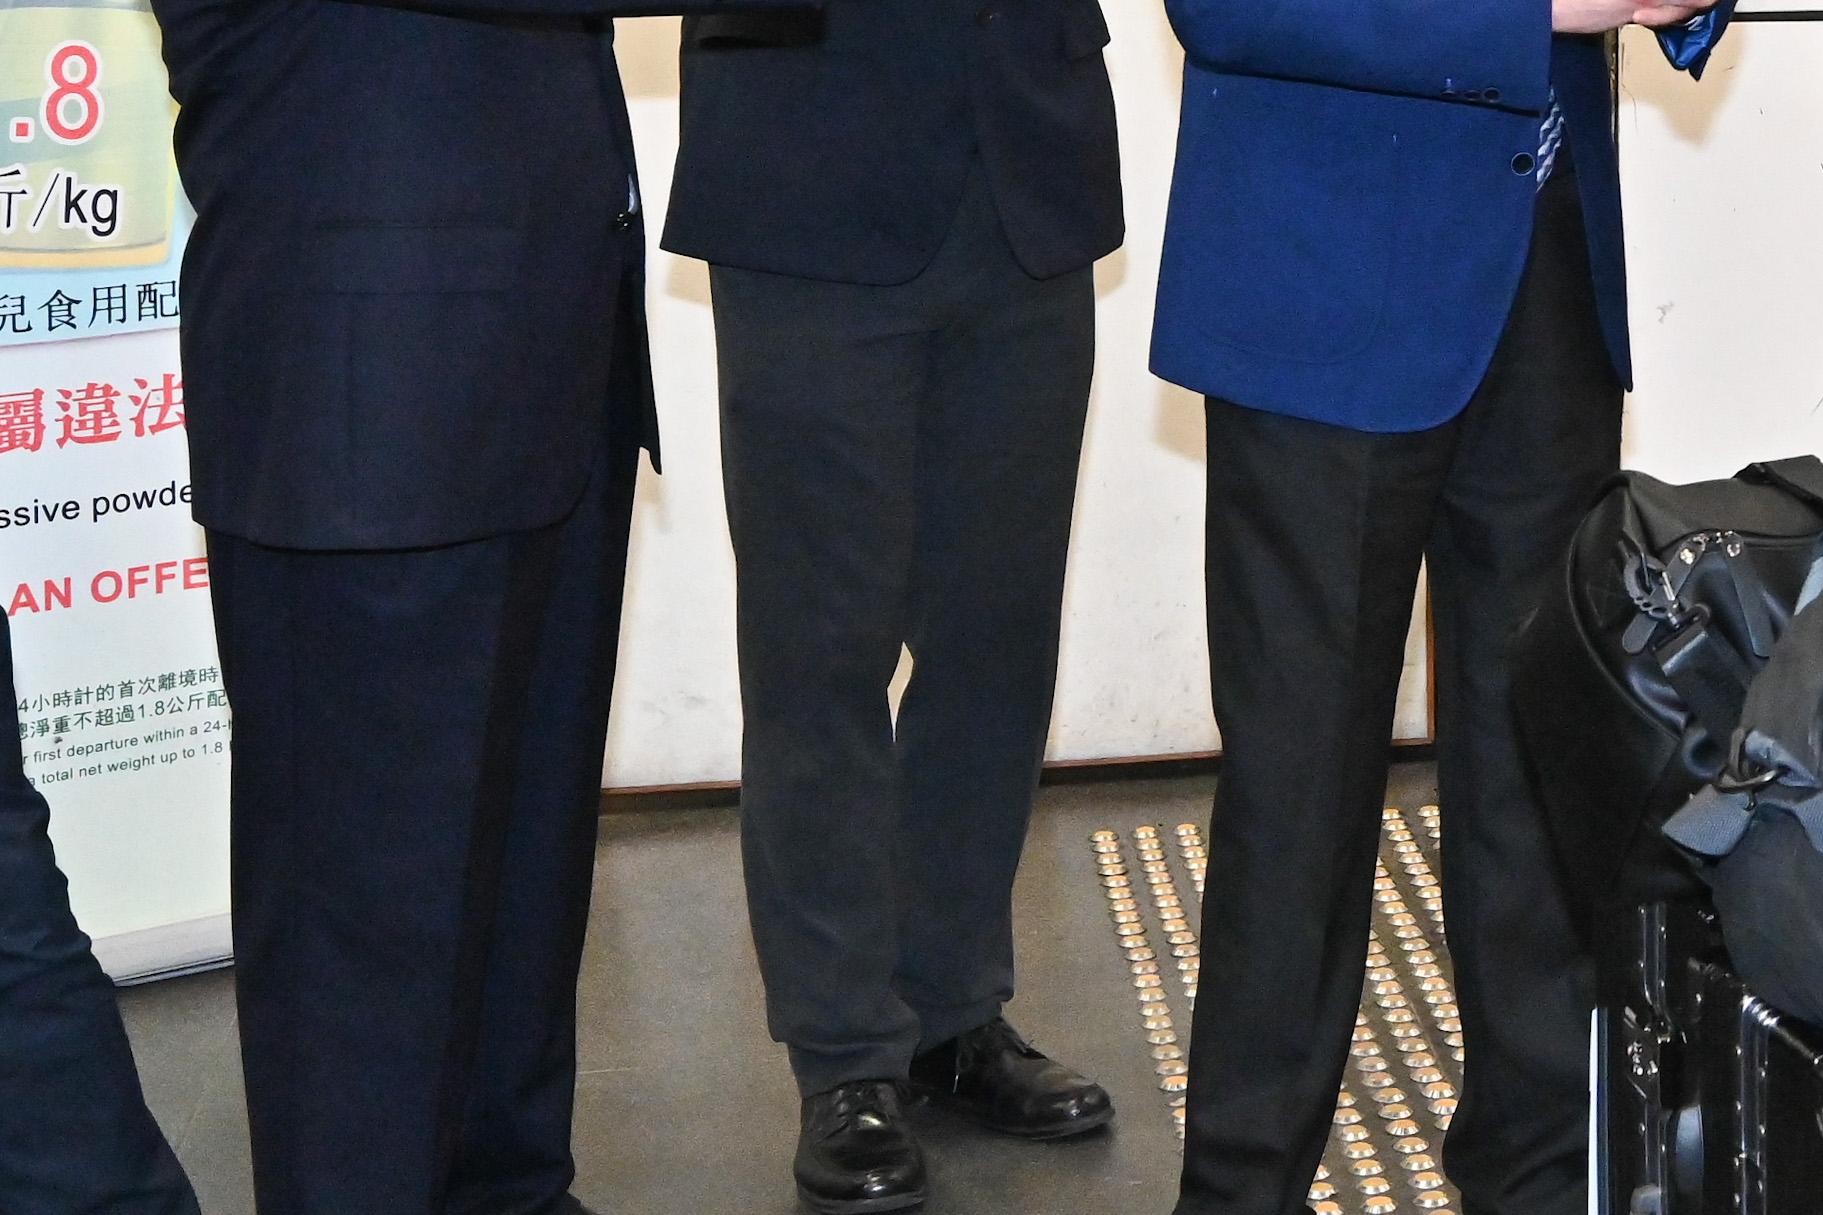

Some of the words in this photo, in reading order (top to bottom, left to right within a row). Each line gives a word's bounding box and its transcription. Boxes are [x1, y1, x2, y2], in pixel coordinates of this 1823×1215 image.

[15, 44, 99, 140] .8
[8, 576, 72, 616] AN
[90, 556, 208, 604] OFFE
[34, 746, 62, 764] first
[66, 735, 139, 760] departure
[143, 726, 185, 745] within
[190, 725, 198, 736] a
[42, 769, 73, 785] total
[79, 764, 102, 779] net
[107, 754, 155, 773] weight
[160, 750, 178, 765] up
[183, 746, 195, 759] to
[203, 741, 223, 755] 1.8
